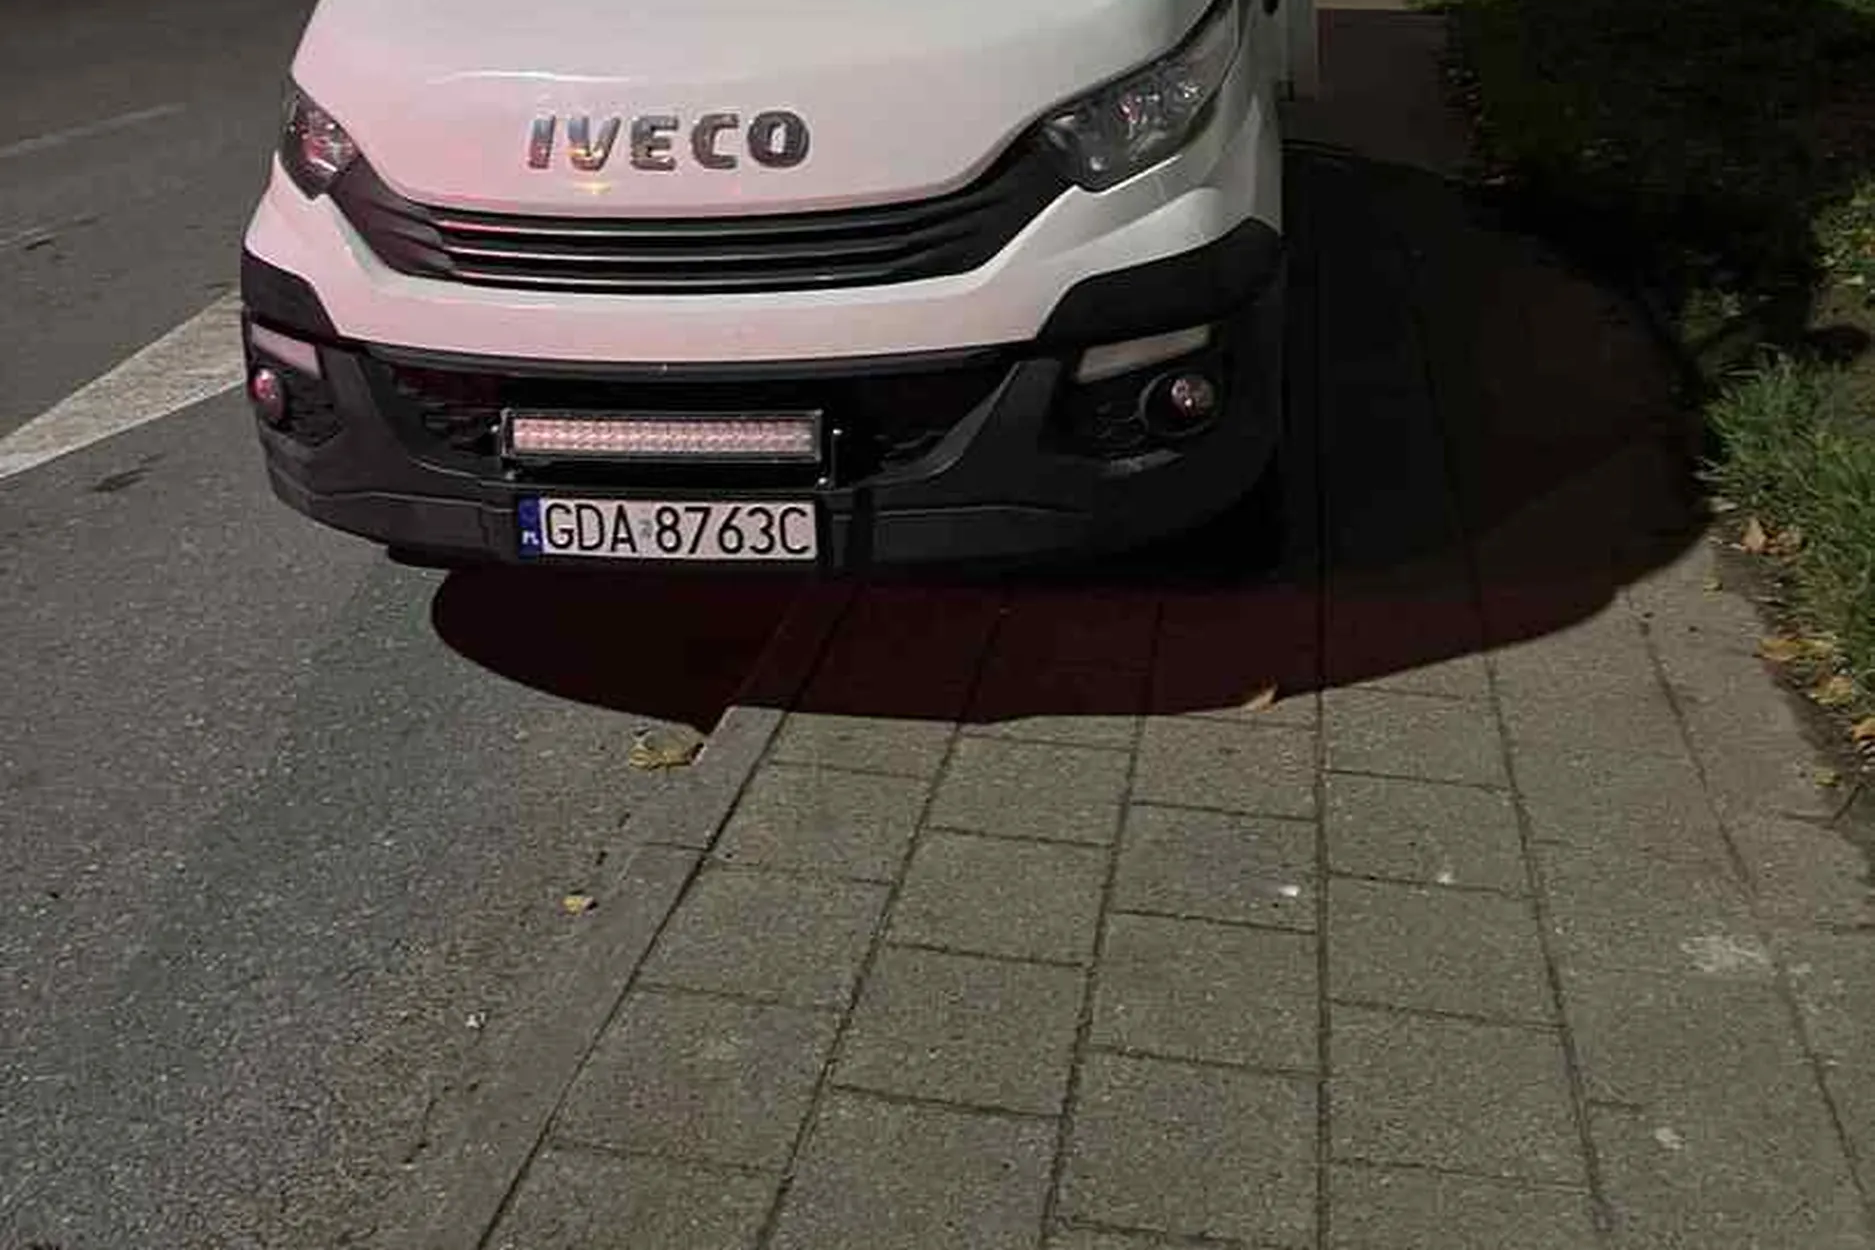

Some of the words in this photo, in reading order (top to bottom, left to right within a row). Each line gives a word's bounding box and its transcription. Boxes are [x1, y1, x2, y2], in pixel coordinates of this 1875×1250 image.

[528, 110, 811, 171] IVECO
[545, 503, 637, 553] GDA
[655, 506, 810, 554] 8763C
